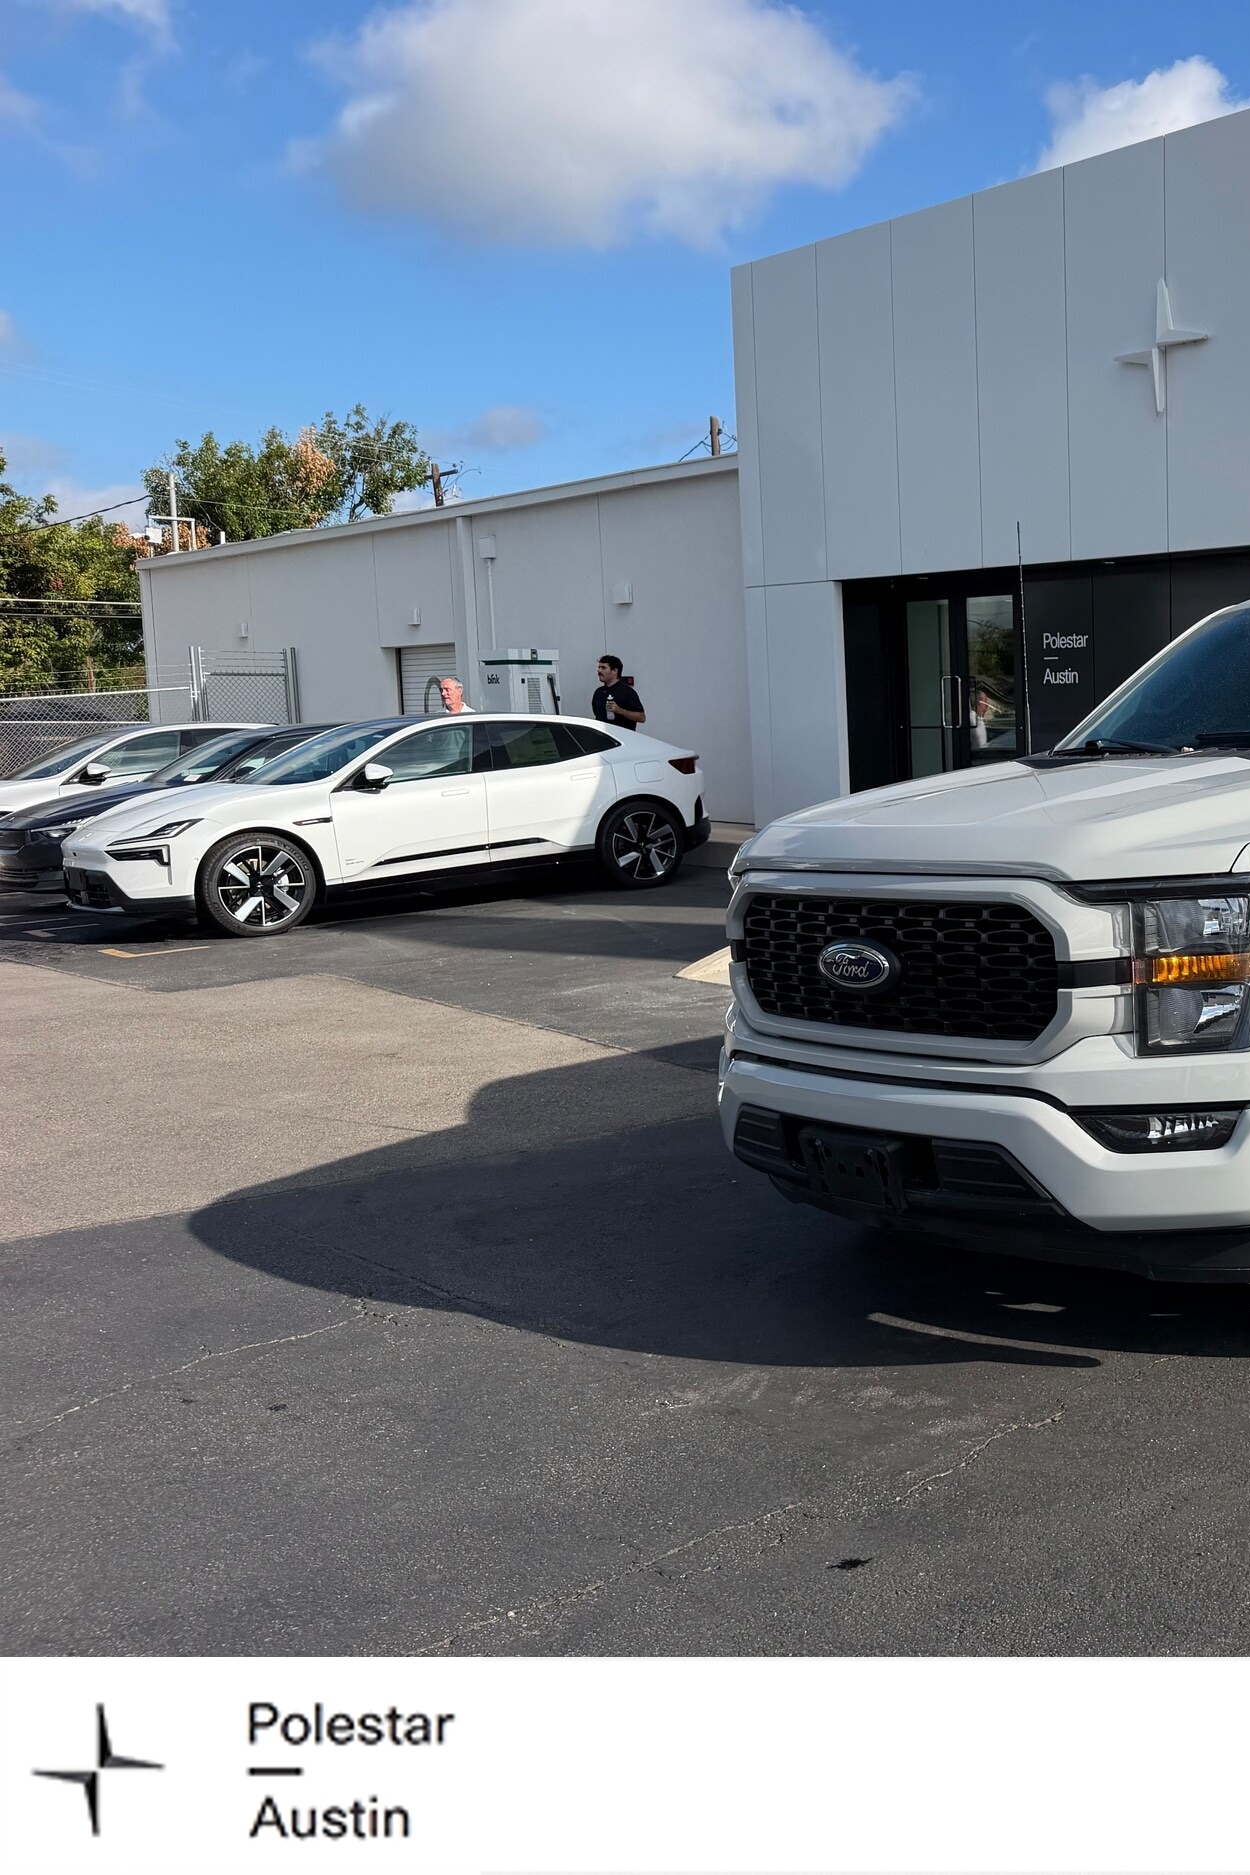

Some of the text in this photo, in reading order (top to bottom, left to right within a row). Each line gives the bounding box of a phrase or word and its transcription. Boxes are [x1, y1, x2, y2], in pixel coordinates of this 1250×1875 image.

[1043, 632, 1089, 650] Polestar
[1043, 668, 1079, 685] Austin
[832, 952, 870, 978] Ford
